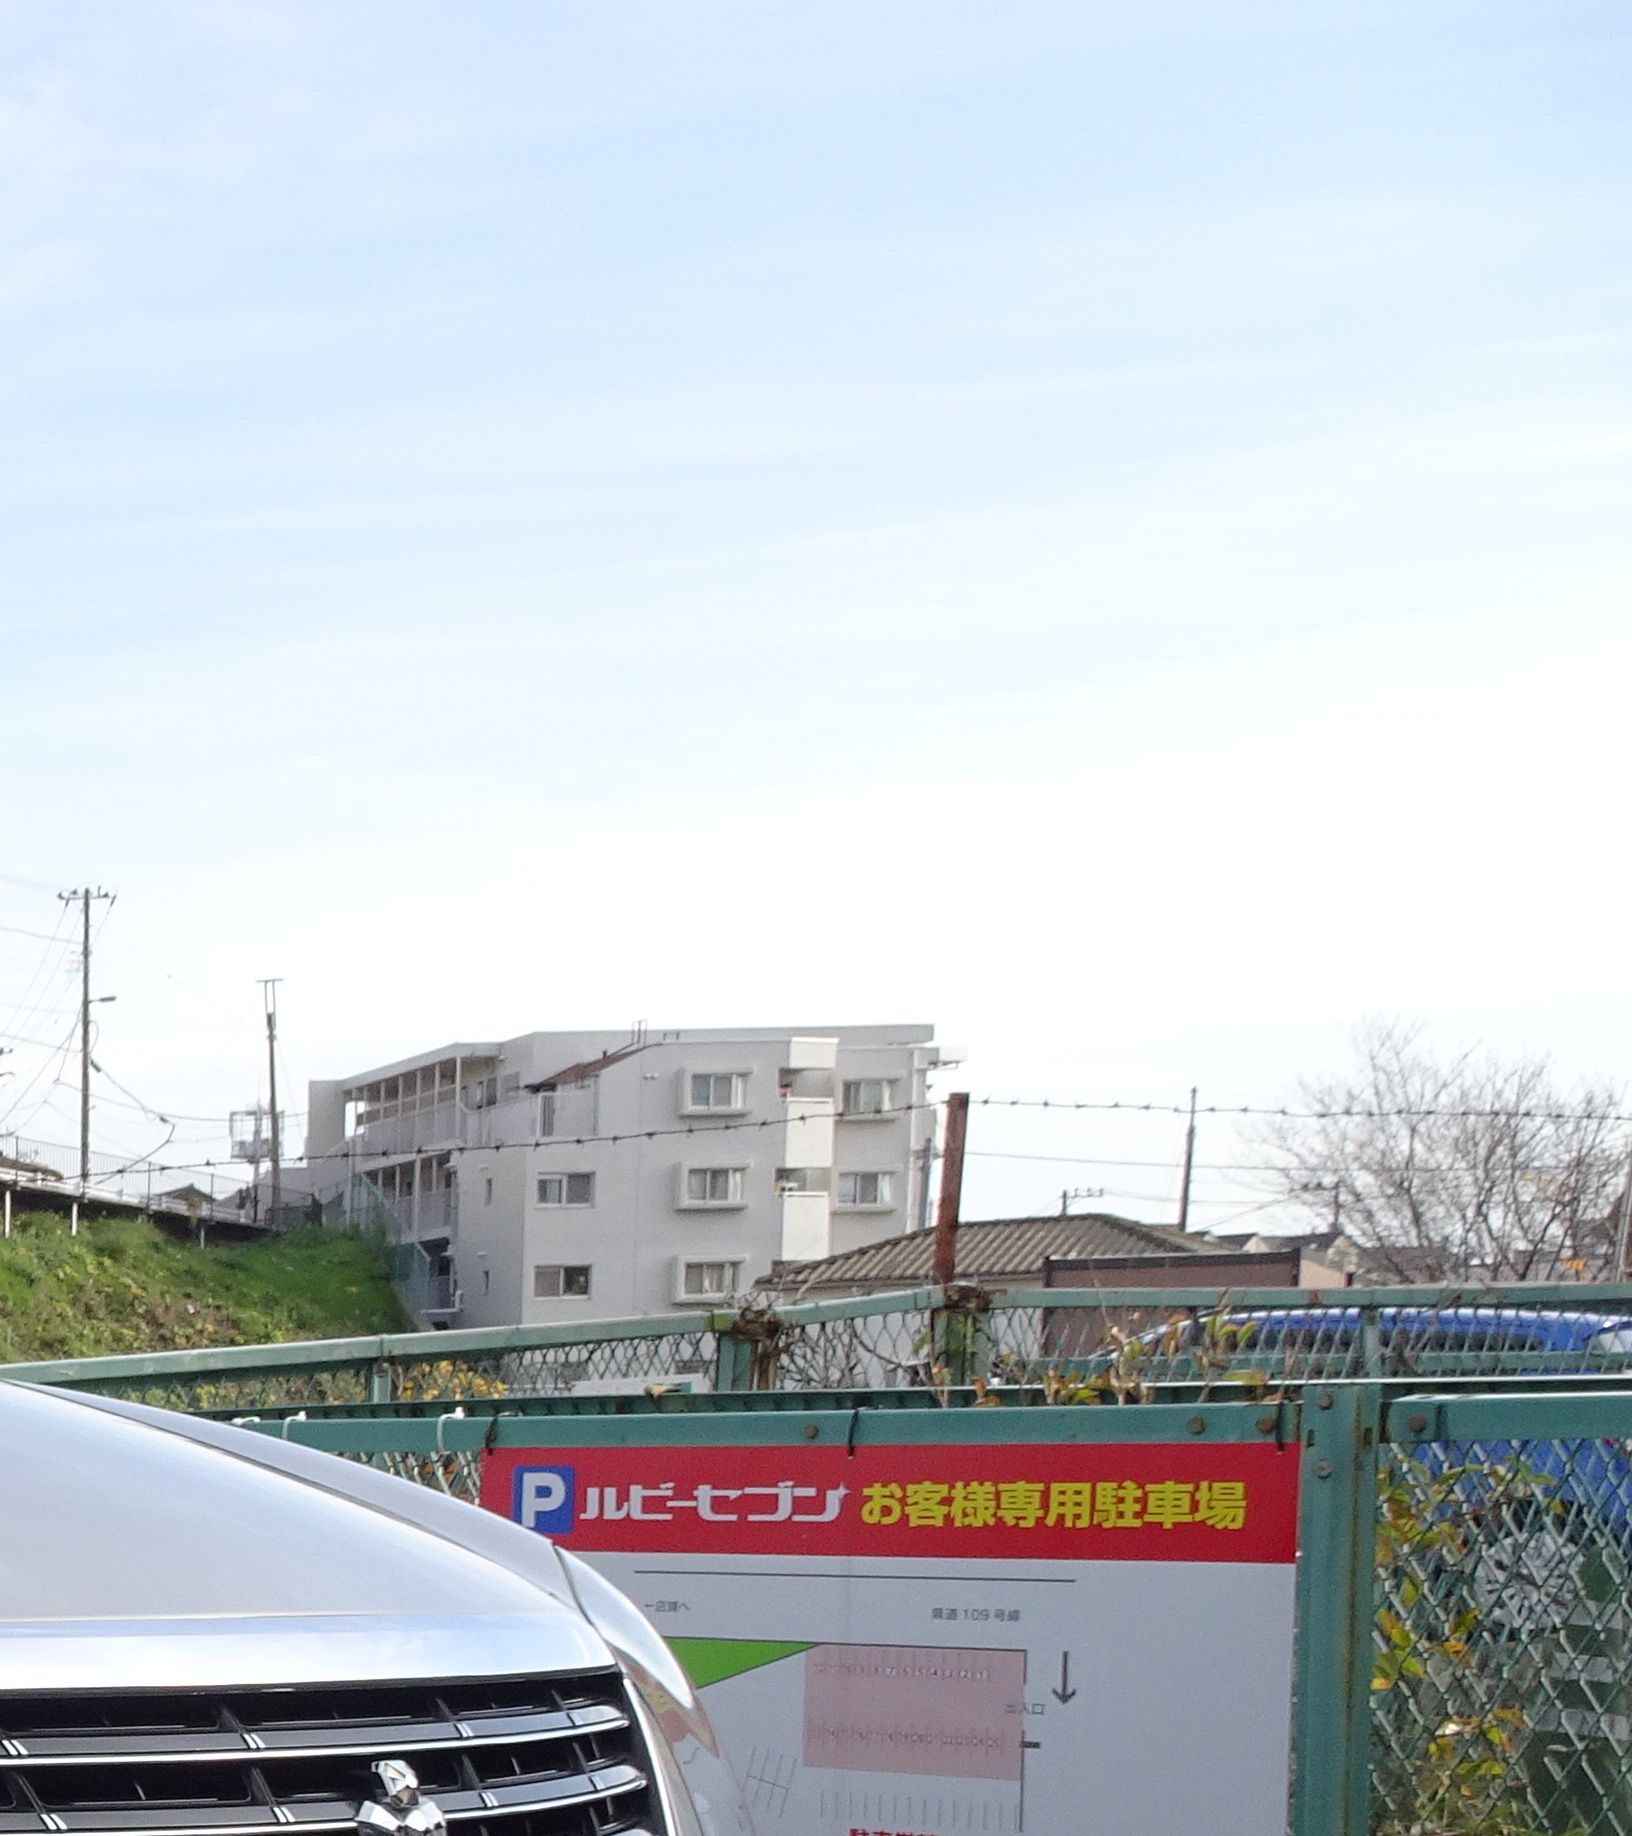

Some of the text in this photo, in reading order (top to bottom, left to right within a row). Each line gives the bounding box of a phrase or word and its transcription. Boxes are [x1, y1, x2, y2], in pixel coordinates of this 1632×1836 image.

[523, 1471, 1247, 1531] P ルビーセブン お客様専用駐車場
[962, 1608, 990, 1621] 109
